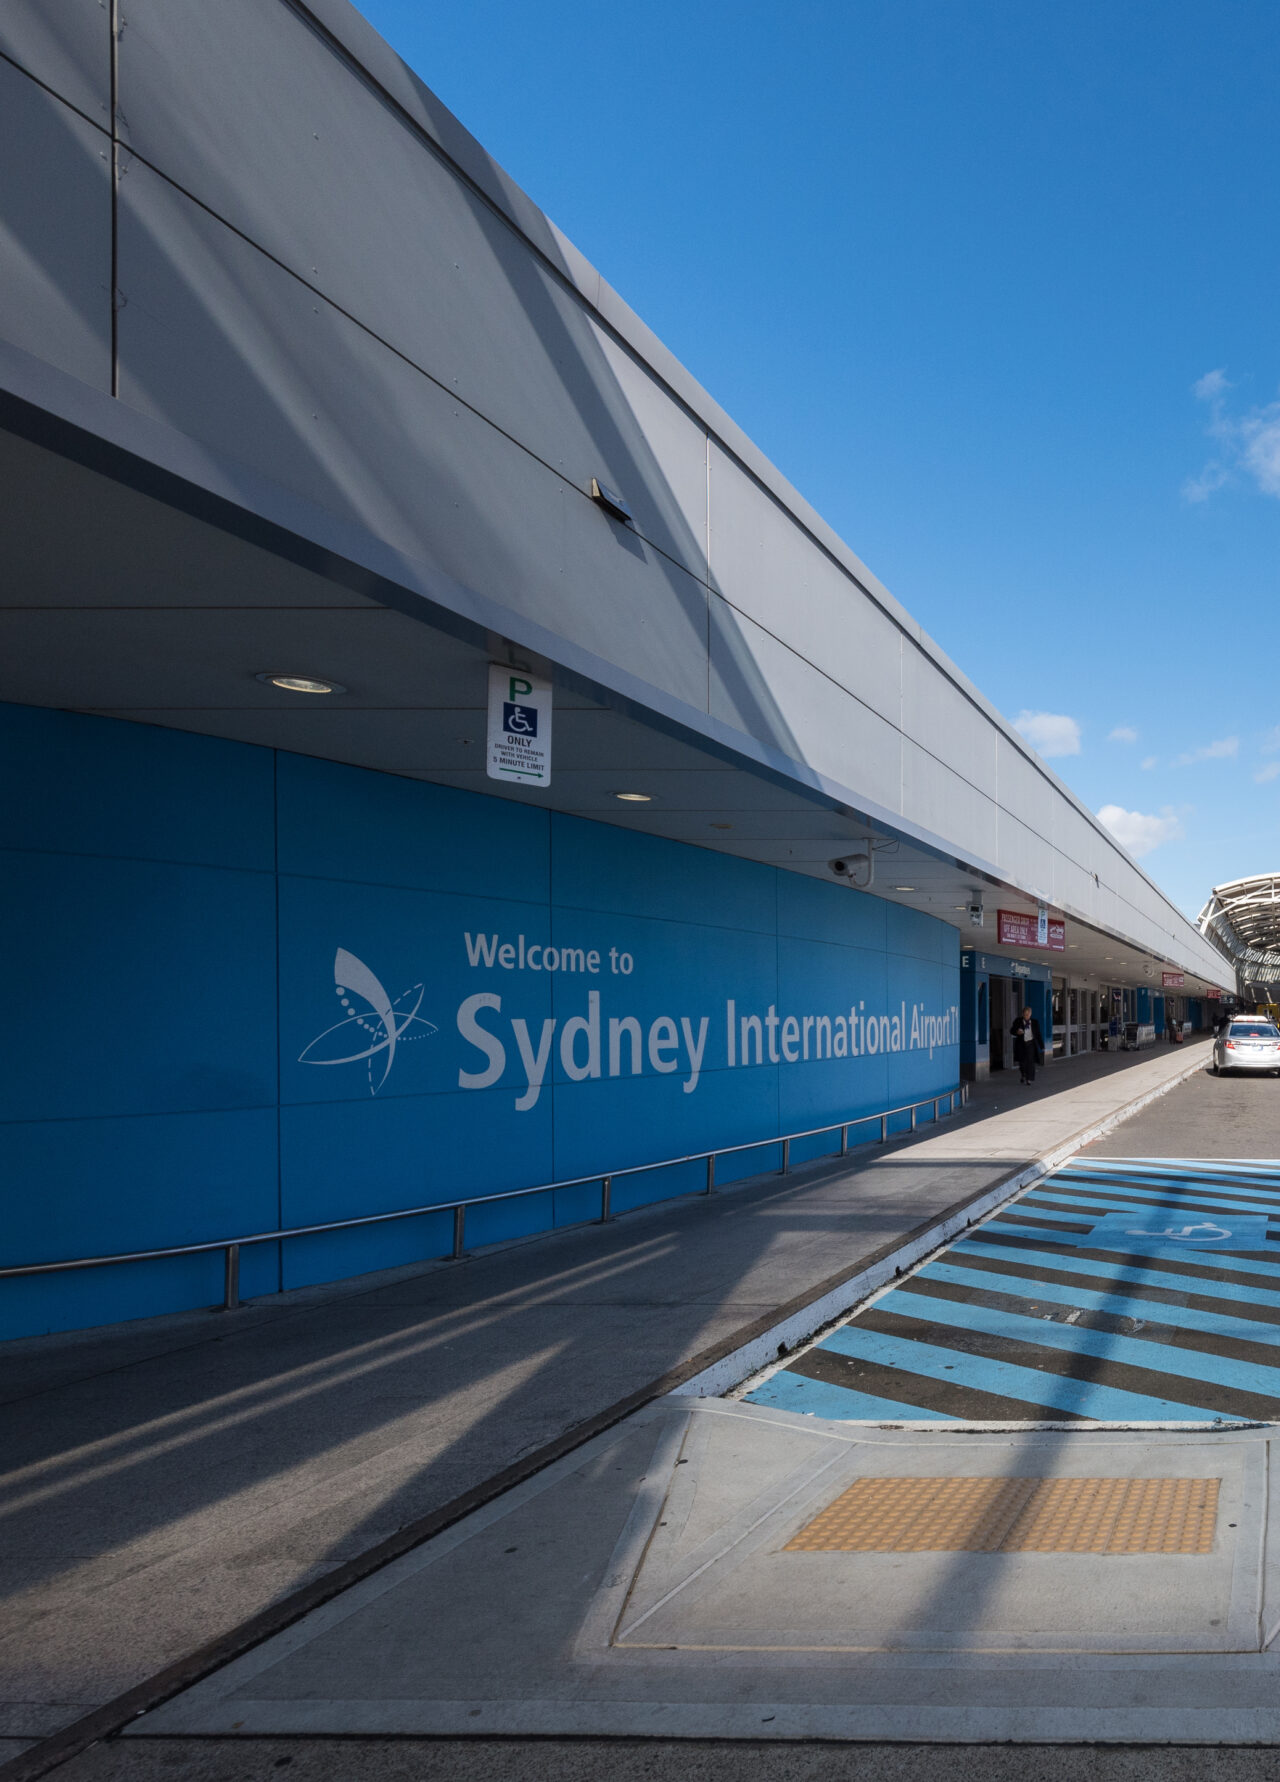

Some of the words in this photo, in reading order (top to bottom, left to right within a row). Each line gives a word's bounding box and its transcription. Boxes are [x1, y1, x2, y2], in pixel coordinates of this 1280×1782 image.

[509, 677, 533, 702] P
[494, 743, 515, 752] DRIVER
[507, 735, 532, 747] ONLY
[499, 757, 525, 768] MINUTE
[526, 762, 545, 771] LIMIT
[516, 754, 538, 762] VEHICLE
[464, 932, 601, 974] Welcome
[609, 947, 634, 975] to
[962, 956, 970, 968] E
[456, 990, 710, 1111] Sydney
[727, 1000, 906, 1067] International
[909, 1002, 950, 1061] Airport
